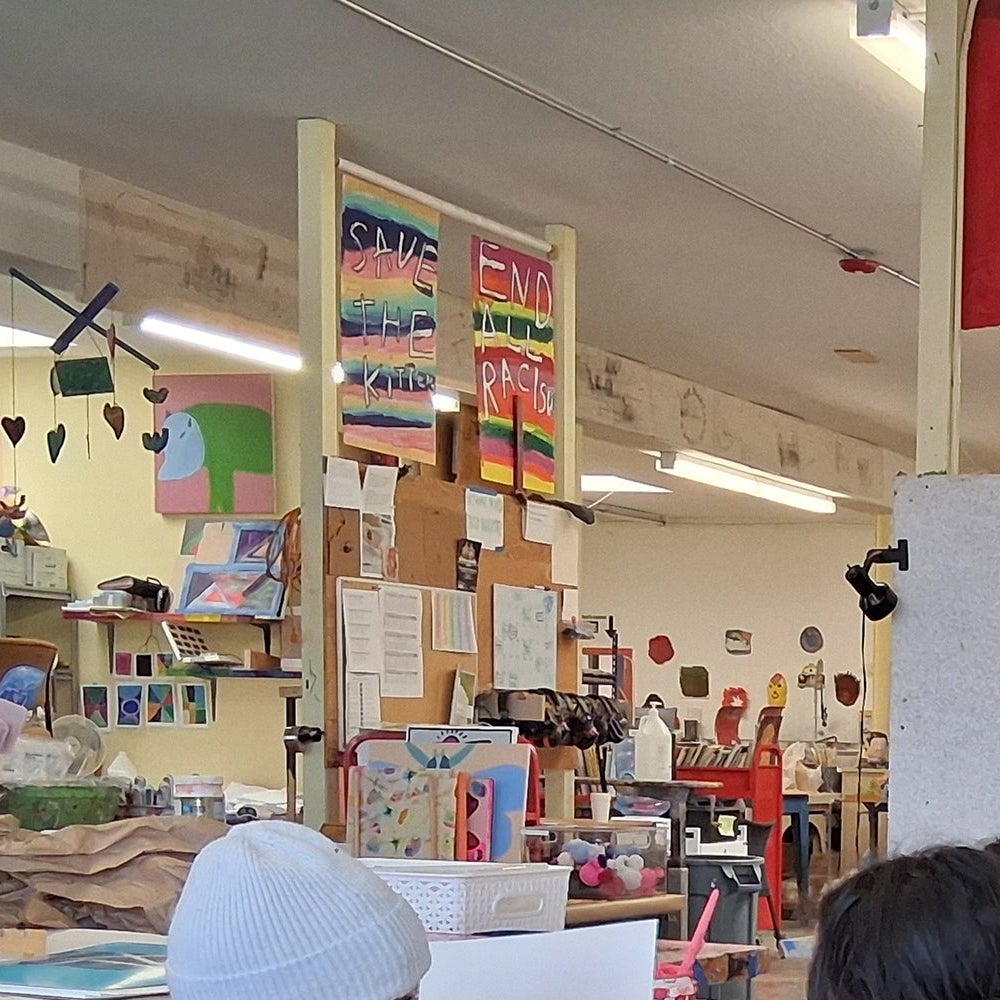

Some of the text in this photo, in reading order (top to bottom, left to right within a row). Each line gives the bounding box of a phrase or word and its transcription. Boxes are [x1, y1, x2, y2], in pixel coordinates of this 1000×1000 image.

[349, 221, 438, 298] SAVE
[478, 240, 553, 330] END
[353, 292, 435, 360] THE
[481, 304, 543, 363] ALL
